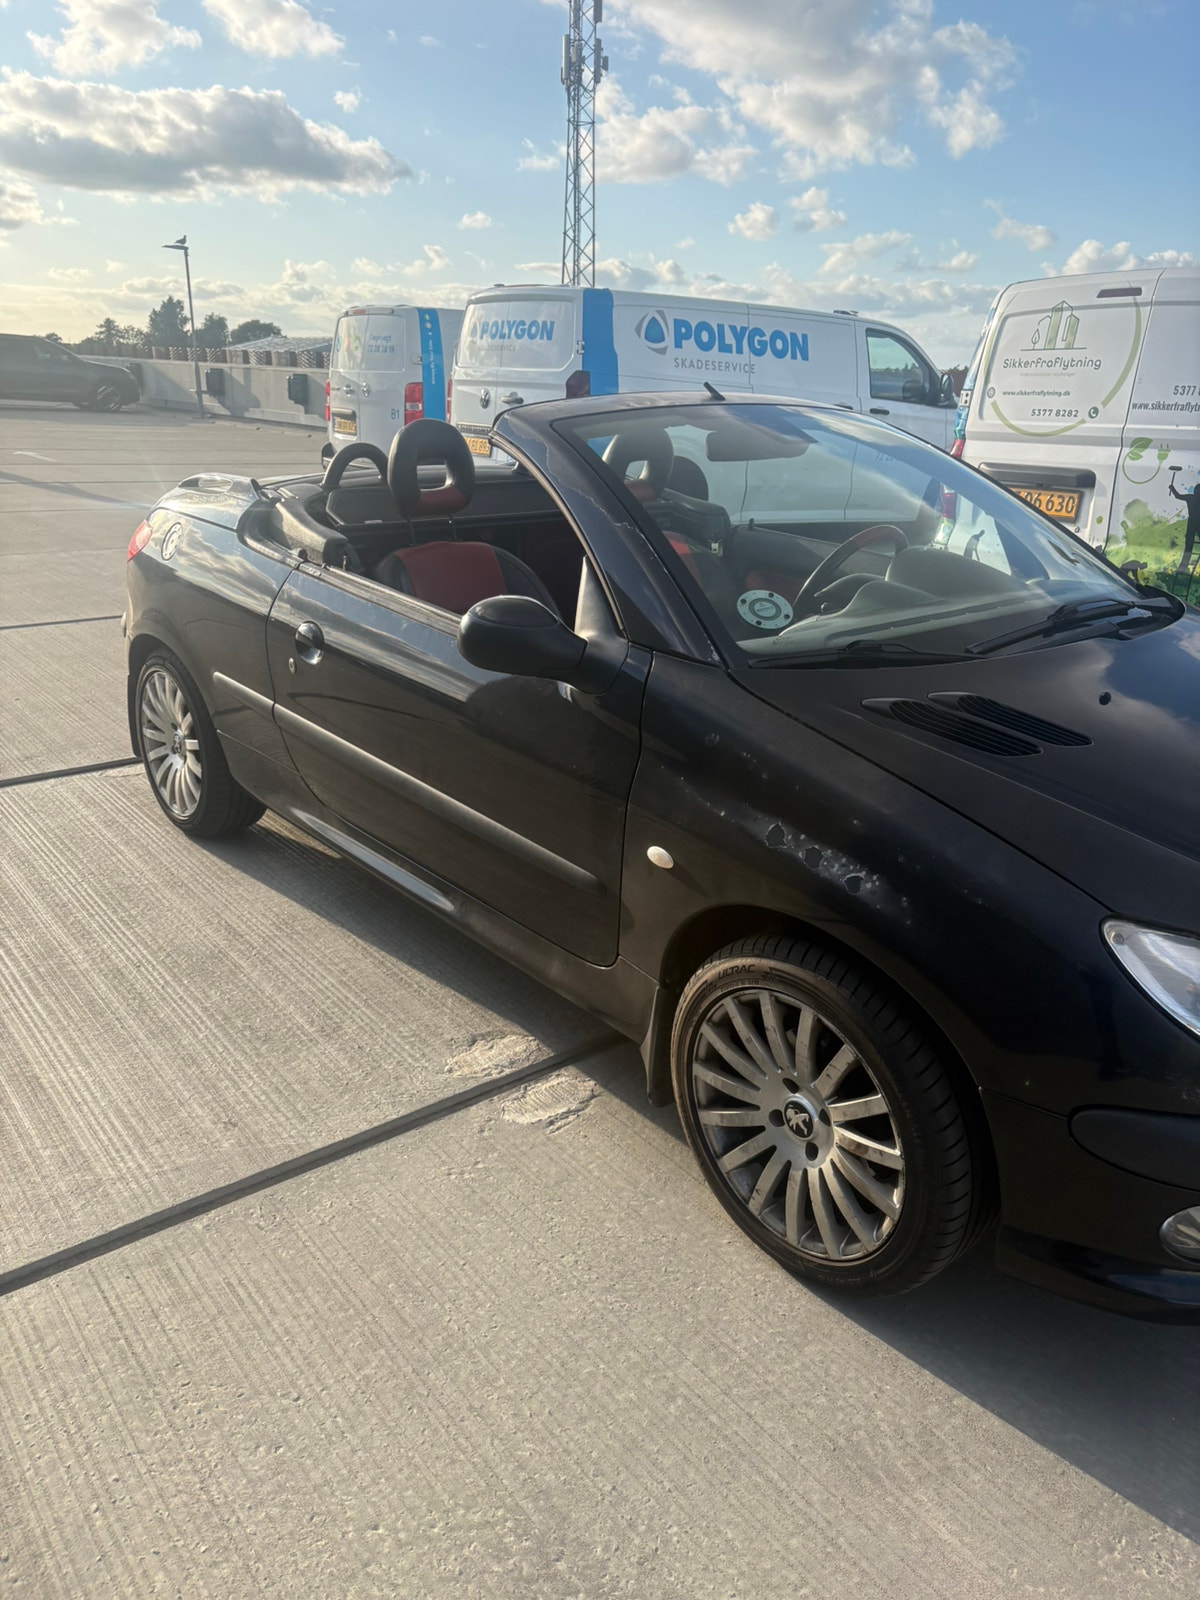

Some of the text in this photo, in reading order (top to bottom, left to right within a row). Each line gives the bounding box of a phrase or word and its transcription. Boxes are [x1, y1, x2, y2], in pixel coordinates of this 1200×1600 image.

[480, 319, 555, 341] POLYGON
[673, 318, 810, 362] POLYGON
[673, 357, 757, 374] SKADESERVICE
[1002, 356, 1102, 371] Sikkerfraflytning
[1002, 389, 1071, 397] www.sikkerfraflytning.dk
[1173, 385, 1197, 396] 5377
[390, 408, 400, 420] 81
[1030, 408, 1079, 418] 5377 8282
[1045, 493, 1076, 514] 630
[717, 964, 756, 980] ULTRAC
